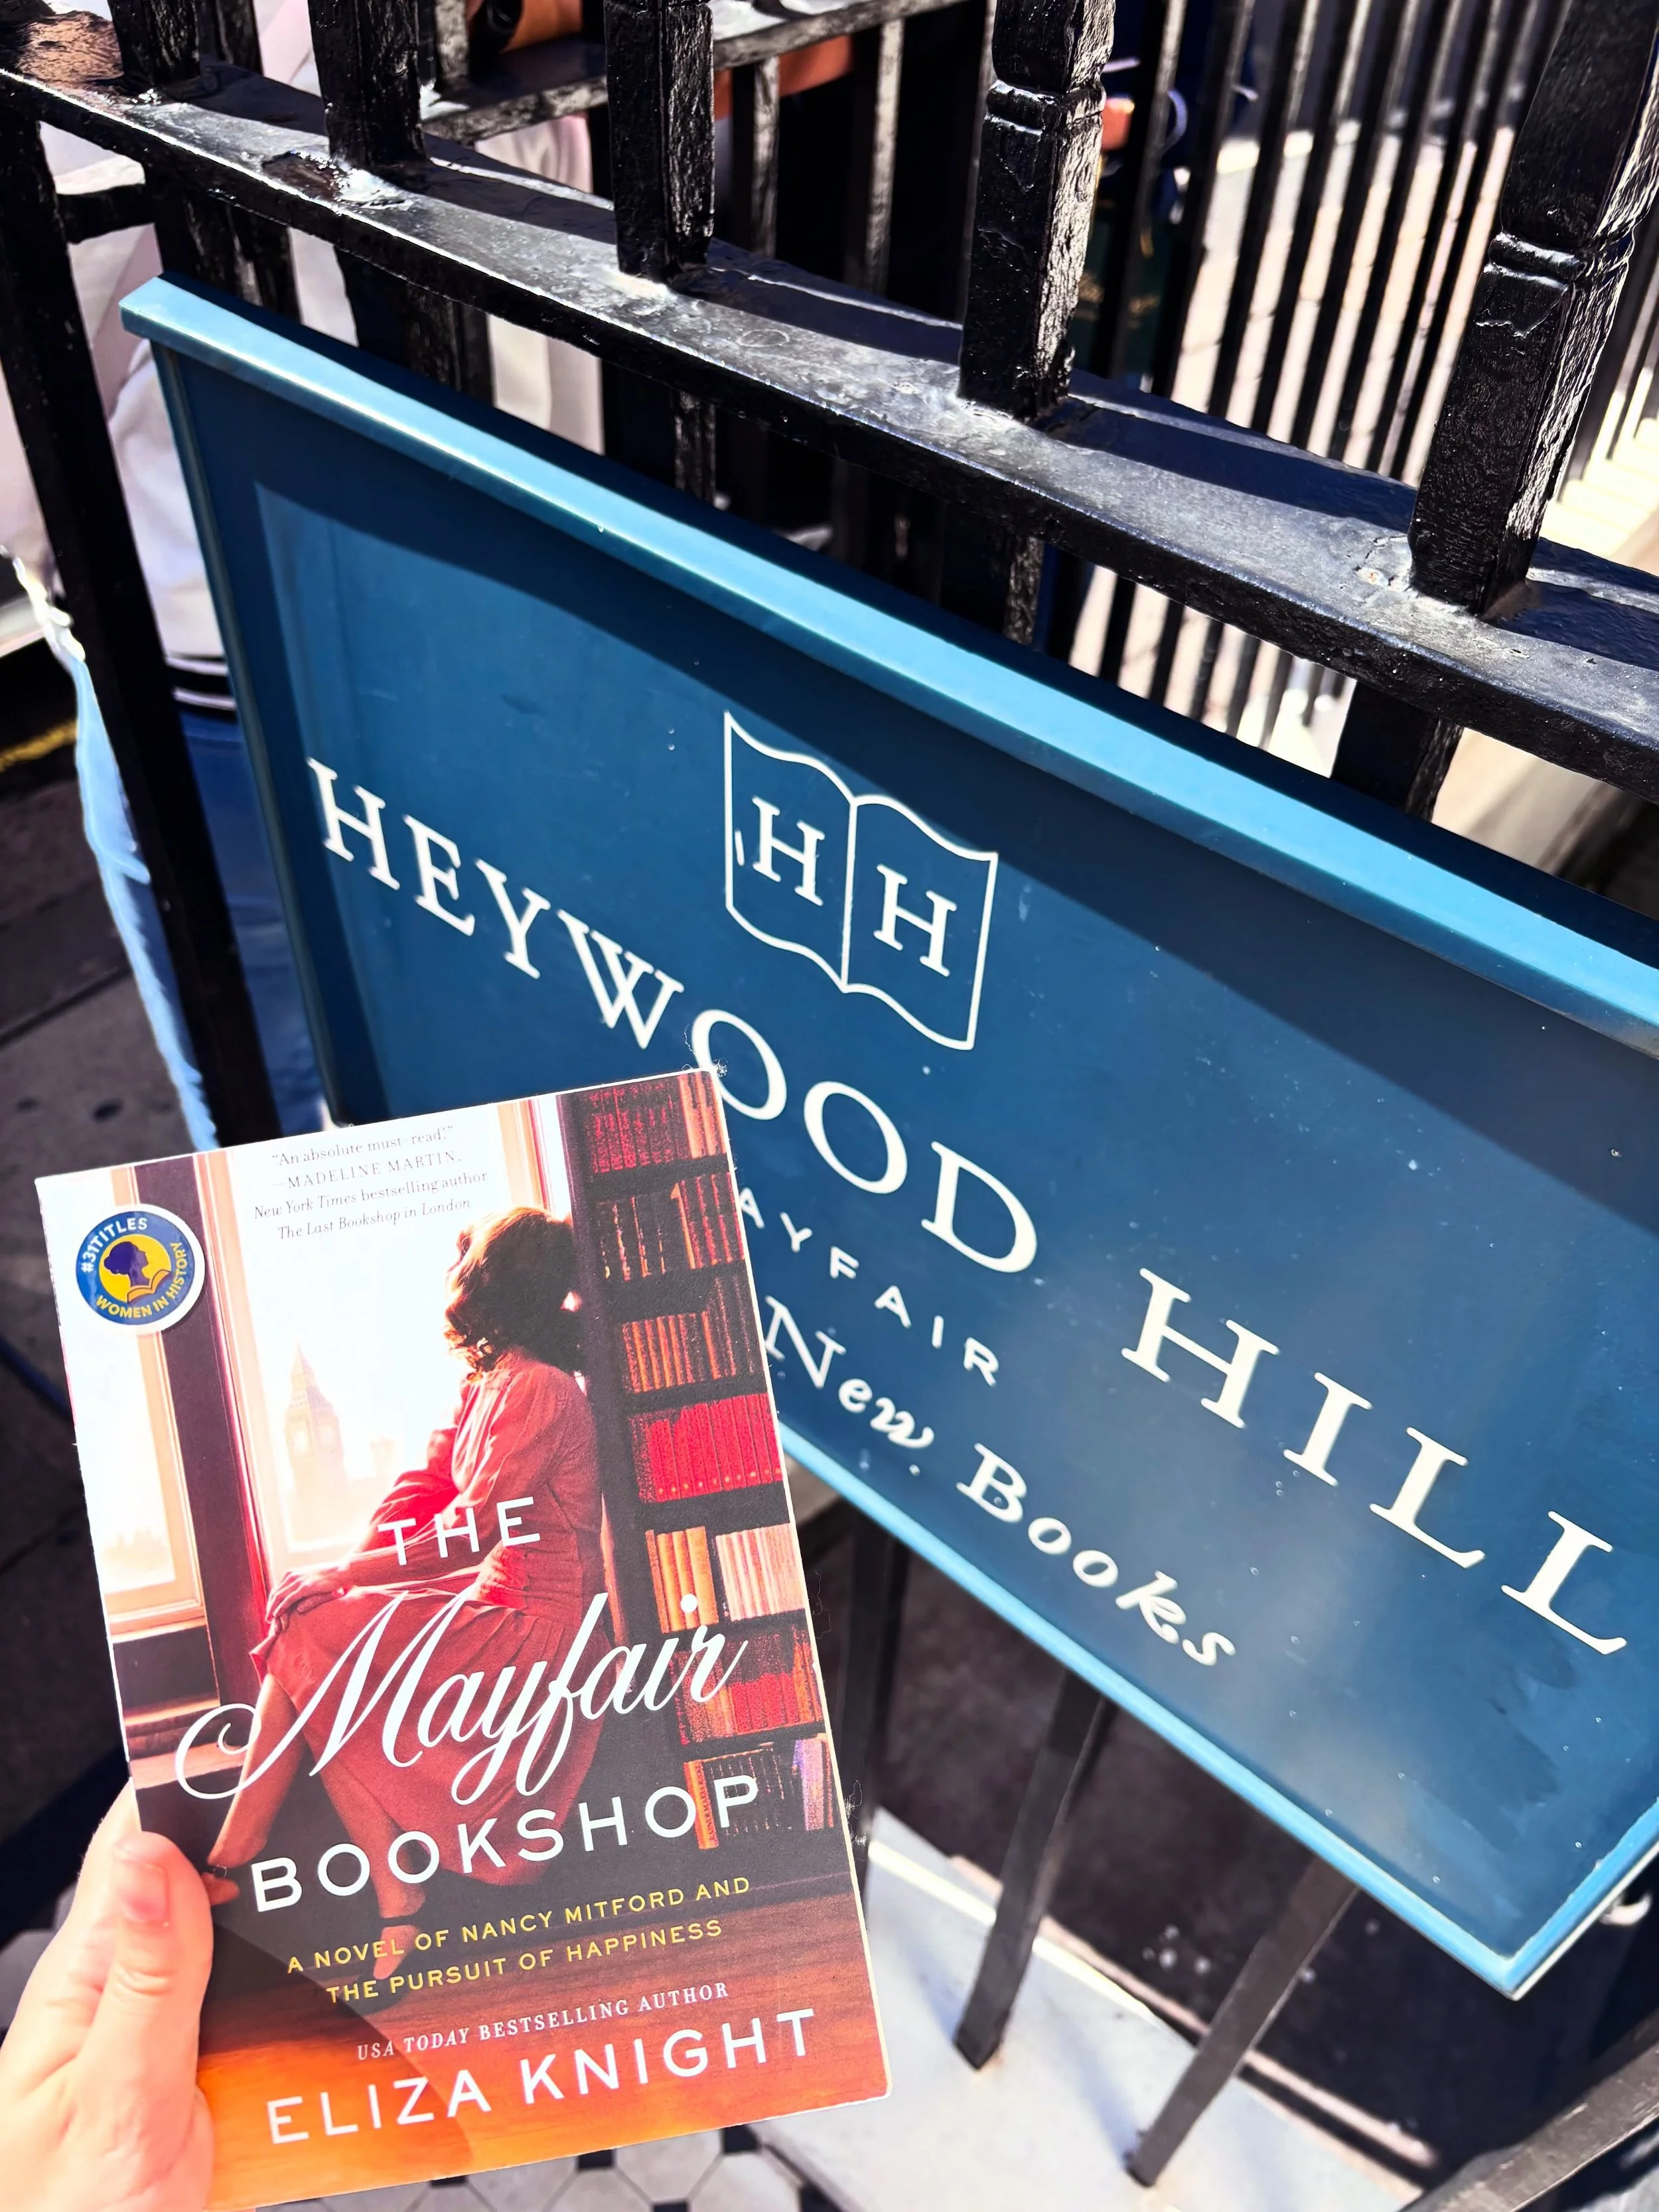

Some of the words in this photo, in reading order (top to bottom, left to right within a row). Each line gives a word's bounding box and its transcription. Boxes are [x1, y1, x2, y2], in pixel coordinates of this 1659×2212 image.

[752, 796, 825, 907] H
[873, 863, 957, 977] H
[254, 1205, 282, 1219] New
[285, 1197, 313, 1214] York
[317, 1195, 357, 1209] Times
[361, 1180, 439, 1201] bestselling
[442, 1172, 487, 1188] author
[303, 1144, 362, 1161] absolute
[80, 1217, 148, 1273] #31TITLES
[278, 1225, 303, 1239] The
[307, 1222, 333, 1235] Last
[339, 1211, 399, 1229] Bookshop
[404, 1207, 417, 1218] in
[422, 1198, 470, 1216] London
[307, 757, 1037, 1273] HEYWOOD
[1121, 1267, 1627, 1656] HILL
[96, 1295, 153, 1319] WOMEN
[152, 1295, 170, 1312] IN
[165, 1242, 188, 1300] HISTORY
[739, 1187, 1000, 1386] AYFAIR
[764, 1295, 934, 1448] New
[956, 1443, 1236, 1666] Books
[378, 1496, 540, 1566] THE
[175, 1582, 748, 1806] Mayfair
[251, 1774, 758, 1913] BOOKSHOP
[287, 1956, 303, 1974] A
[314, 1938, 405, 1969] NOVEL
[415, 1929, 449, 1951] OF
[462, 1910, 552, 1943] NANCY
[565, 1888, 684, 1924] MITFORD
[696, 1877, 749, 1901] AND
[326, 1980, 379, 2004] THE
[390, 1958, 506, 1994] PURSUIT
[519, 1949, 553, 1971] OF
[567, 1919, 722, 1962] HAPPINESS
[357, 2039, 395, 2060] USA
[403, 2027, 470, 2053] TODAY
[478, 1998, 628, 2040] BESTSELLING
[638, 1982, 729, 2012] AUTHOR
[266, 2070, 490, 2145] ELIZA
[520, 2008, 815, 2104] KNIGHT
